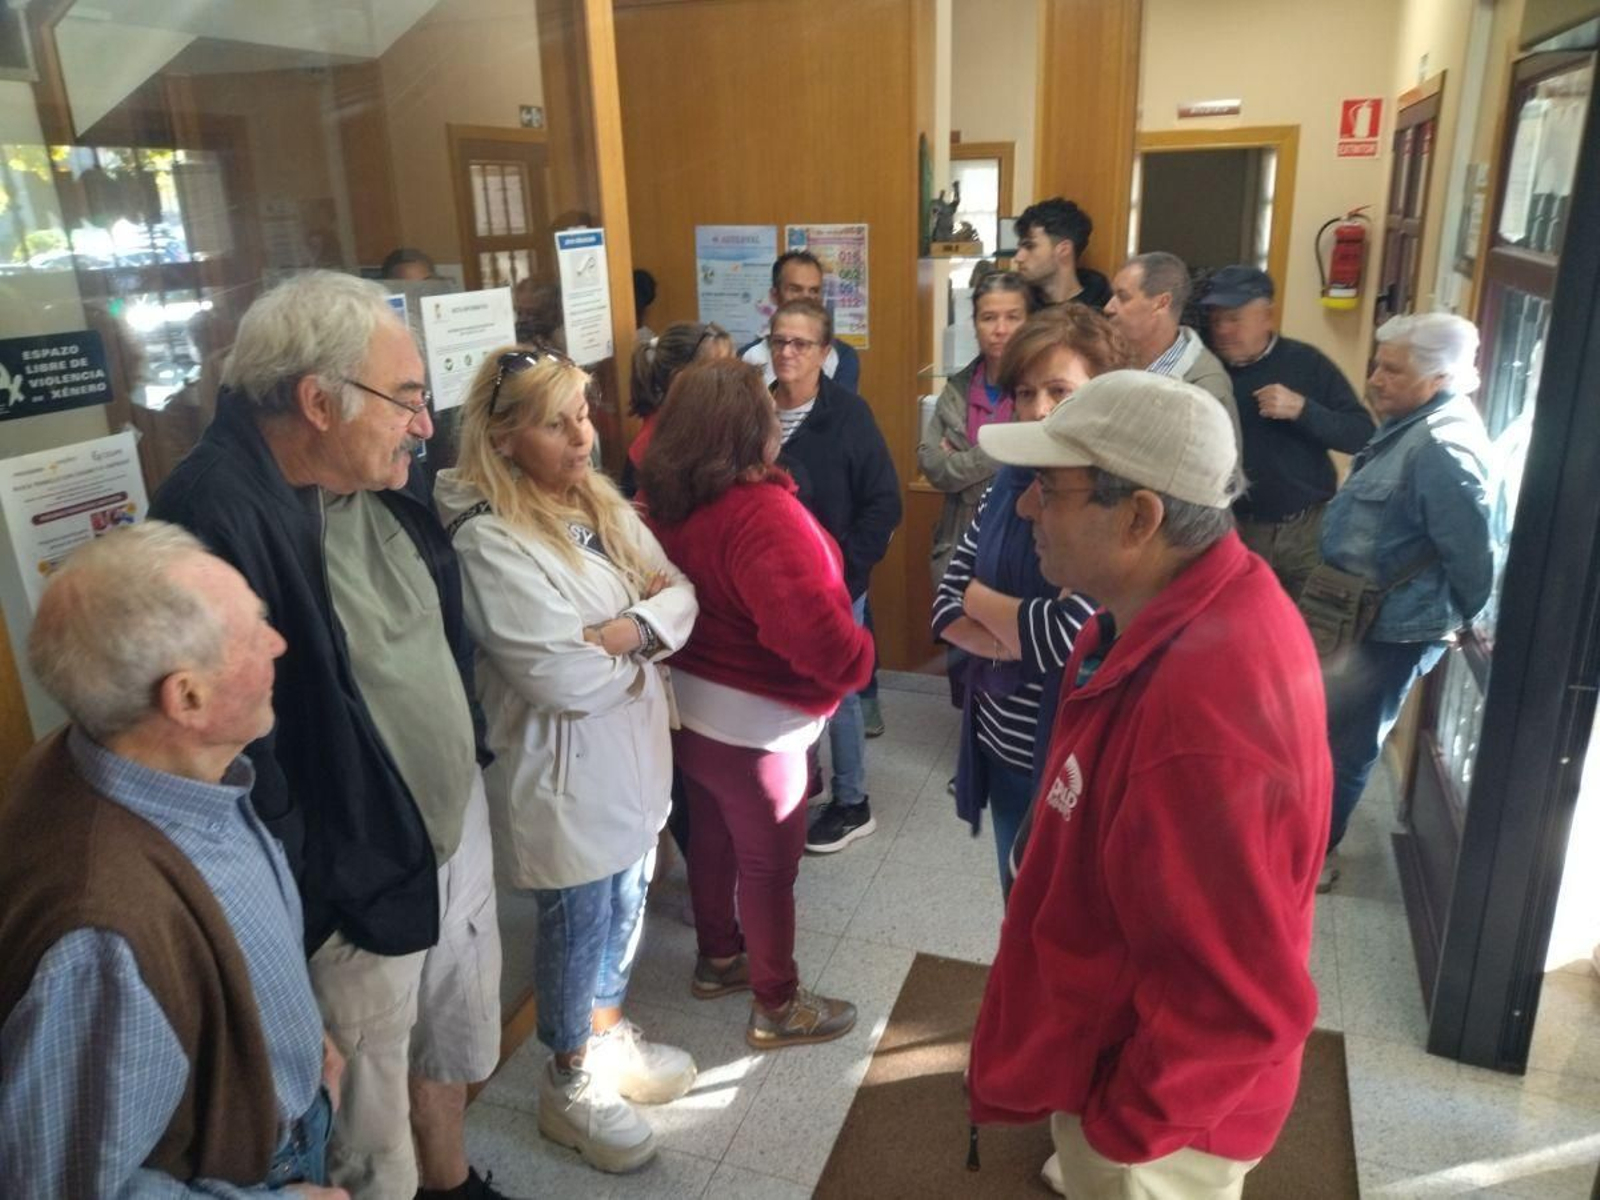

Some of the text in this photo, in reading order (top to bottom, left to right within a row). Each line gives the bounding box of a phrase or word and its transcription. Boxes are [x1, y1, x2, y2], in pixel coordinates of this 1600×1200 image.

[22, 345, 79, 361] ESPAZO
[25, 357, 89, 375] LIBRE DE
[28, 369, 105, 388] VIOLENCIA
[50, 382, 107, 400] XÉNERO
